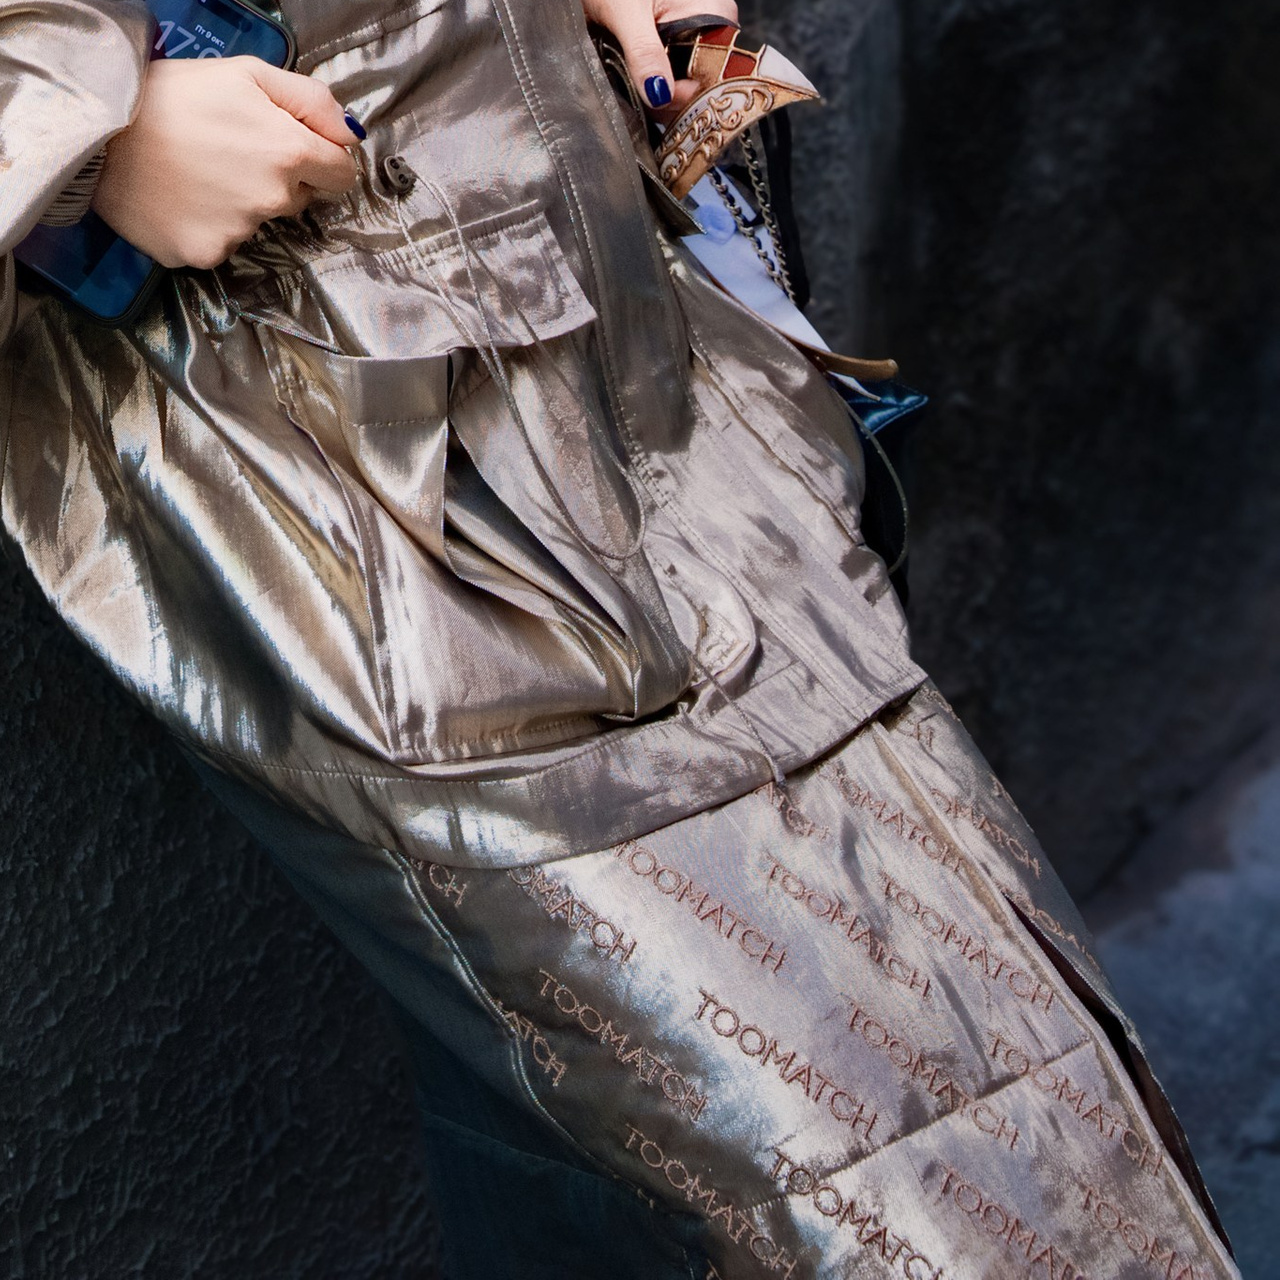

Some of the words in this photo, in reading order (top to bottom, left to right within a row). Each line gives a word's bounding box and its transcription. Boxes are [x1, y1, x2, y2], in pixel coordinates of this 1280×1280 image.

[195, 24, 206, 36] Пт
[205, 31, 212, 39] 9
[764, 851, 931, 998] TOOMATCH
[880, 871, 1055, 1013] TOOMATCH
[540, 969, 707, 1119] TOOMATCH
[697, 987, 877, 1139] TOOMATCH
[842, 994, 1018, 1149] TOOMATCH
[986, 1031, 1164, 1176] TOOMATCH
[625, 1123, 797, 1280] TOOMATCH
[770, 1147, 943, 1280] TOOMATC
